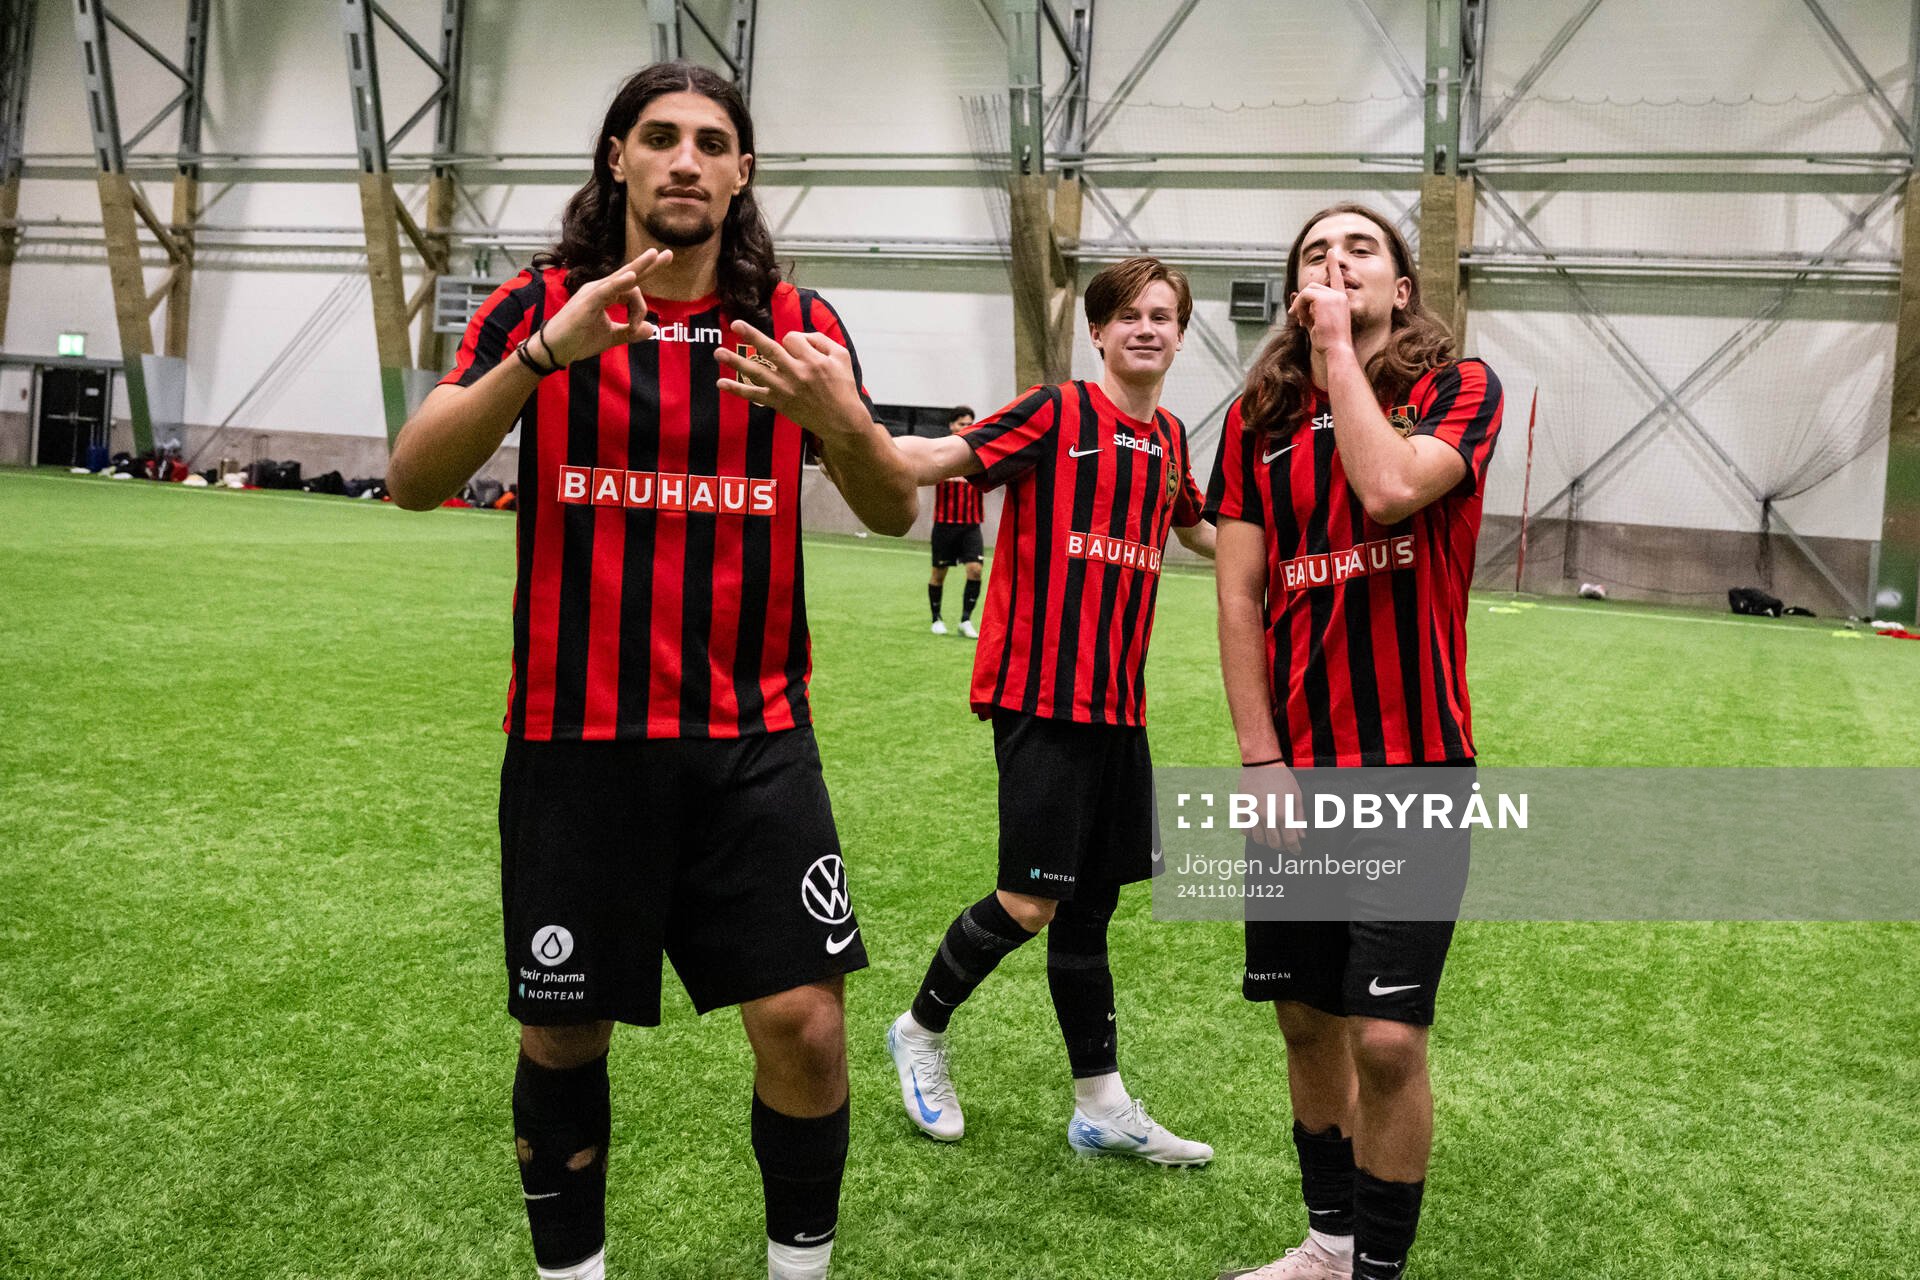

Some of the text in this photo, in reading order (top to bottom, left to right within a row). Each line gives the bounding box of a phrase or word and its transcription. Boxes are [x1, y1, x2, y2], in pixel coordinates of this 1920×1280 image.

[1113, 432, 1163, 458] stadium
[564, 471, 774, 511] BAUHAUS
[1285, 540, 1414, 587] BAUHAUS
[542, 972, 585, 984] pharma
[1248, 972, 1291, 981] NORTEAM
[528, 989, 584, 1001] NORTEAM
